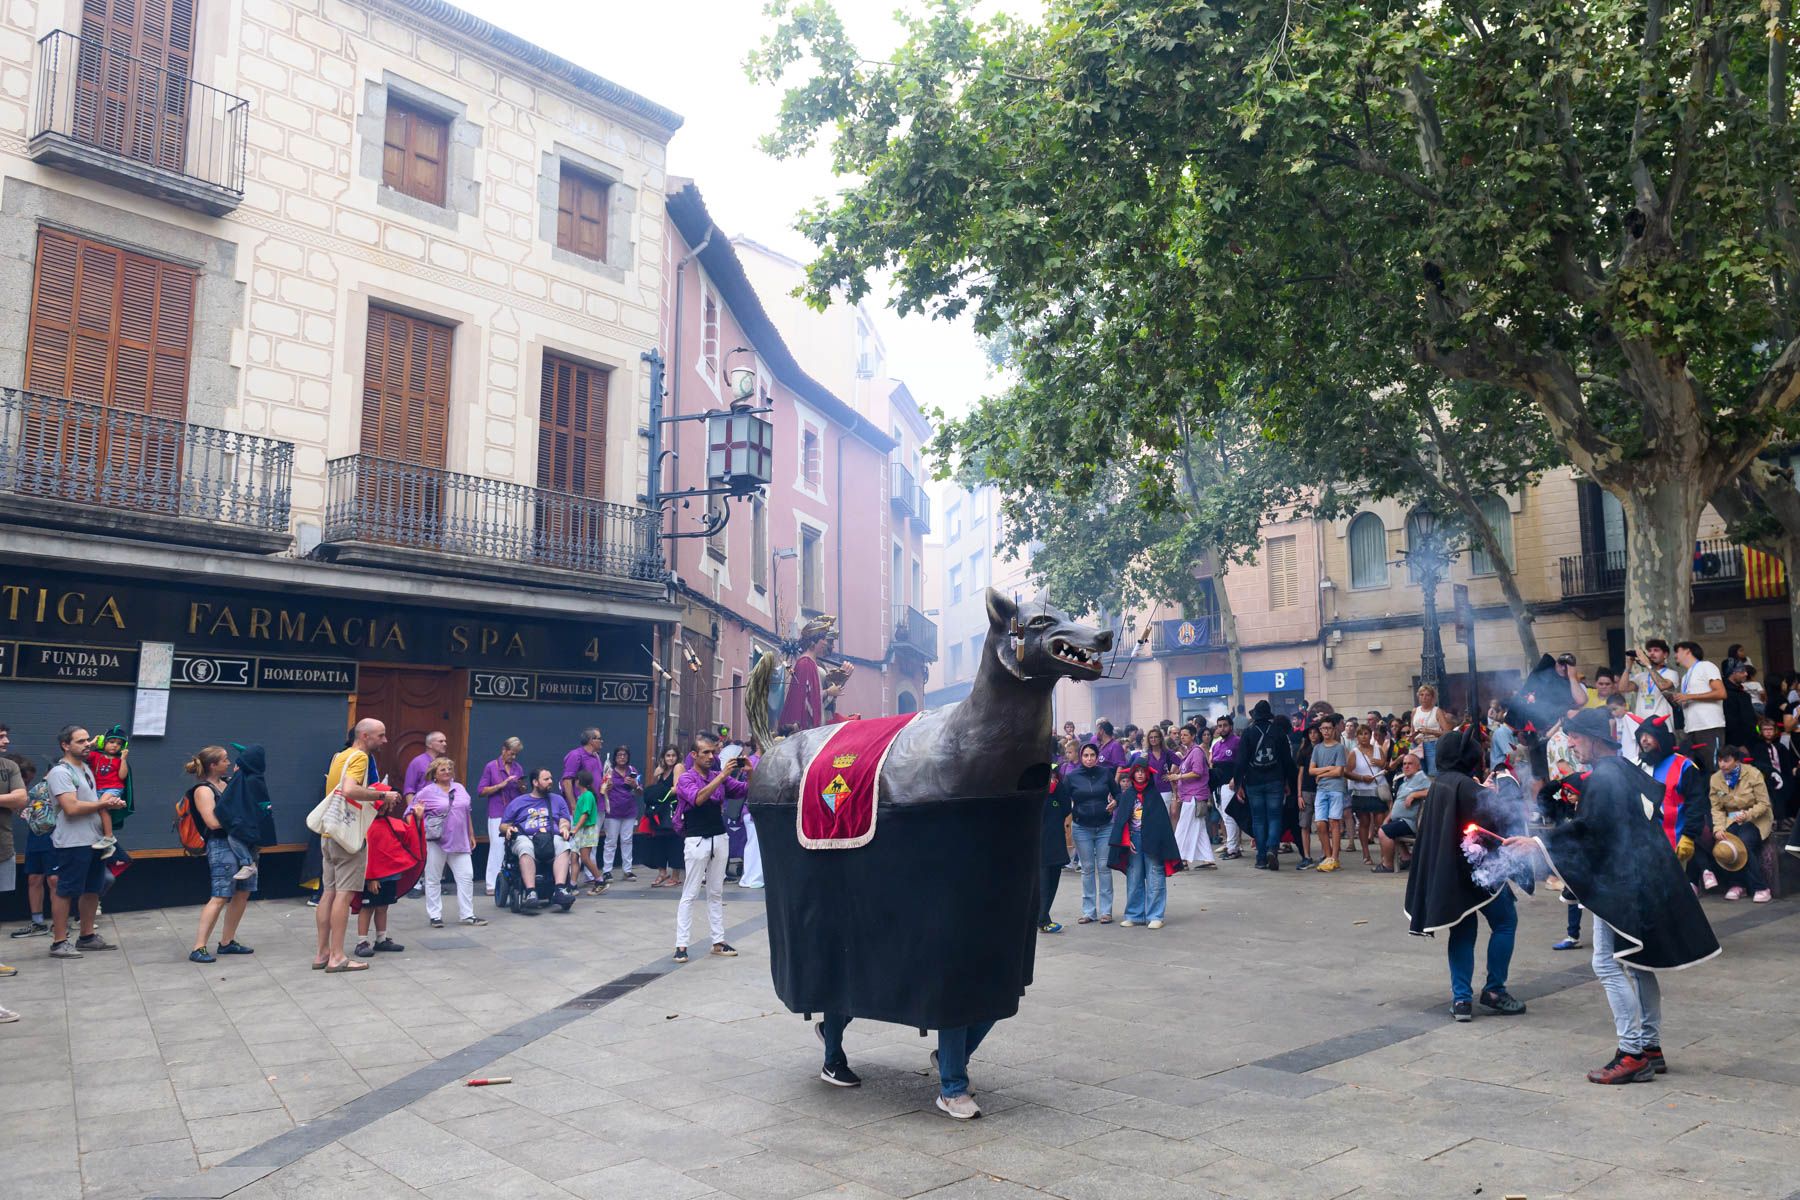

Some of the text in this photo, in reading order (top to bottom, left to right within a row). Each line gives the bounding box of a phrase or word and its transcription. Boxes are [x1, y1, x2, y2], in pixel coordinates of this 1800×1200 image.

[3, 586, 599, 661] TIGA FARMACIA SPA 4
[40, 650, 120, 668] FUNDADA
[57, 668, 98, 677] AL 1635
[264, 668, 349, 682] HOMEOPATIA
